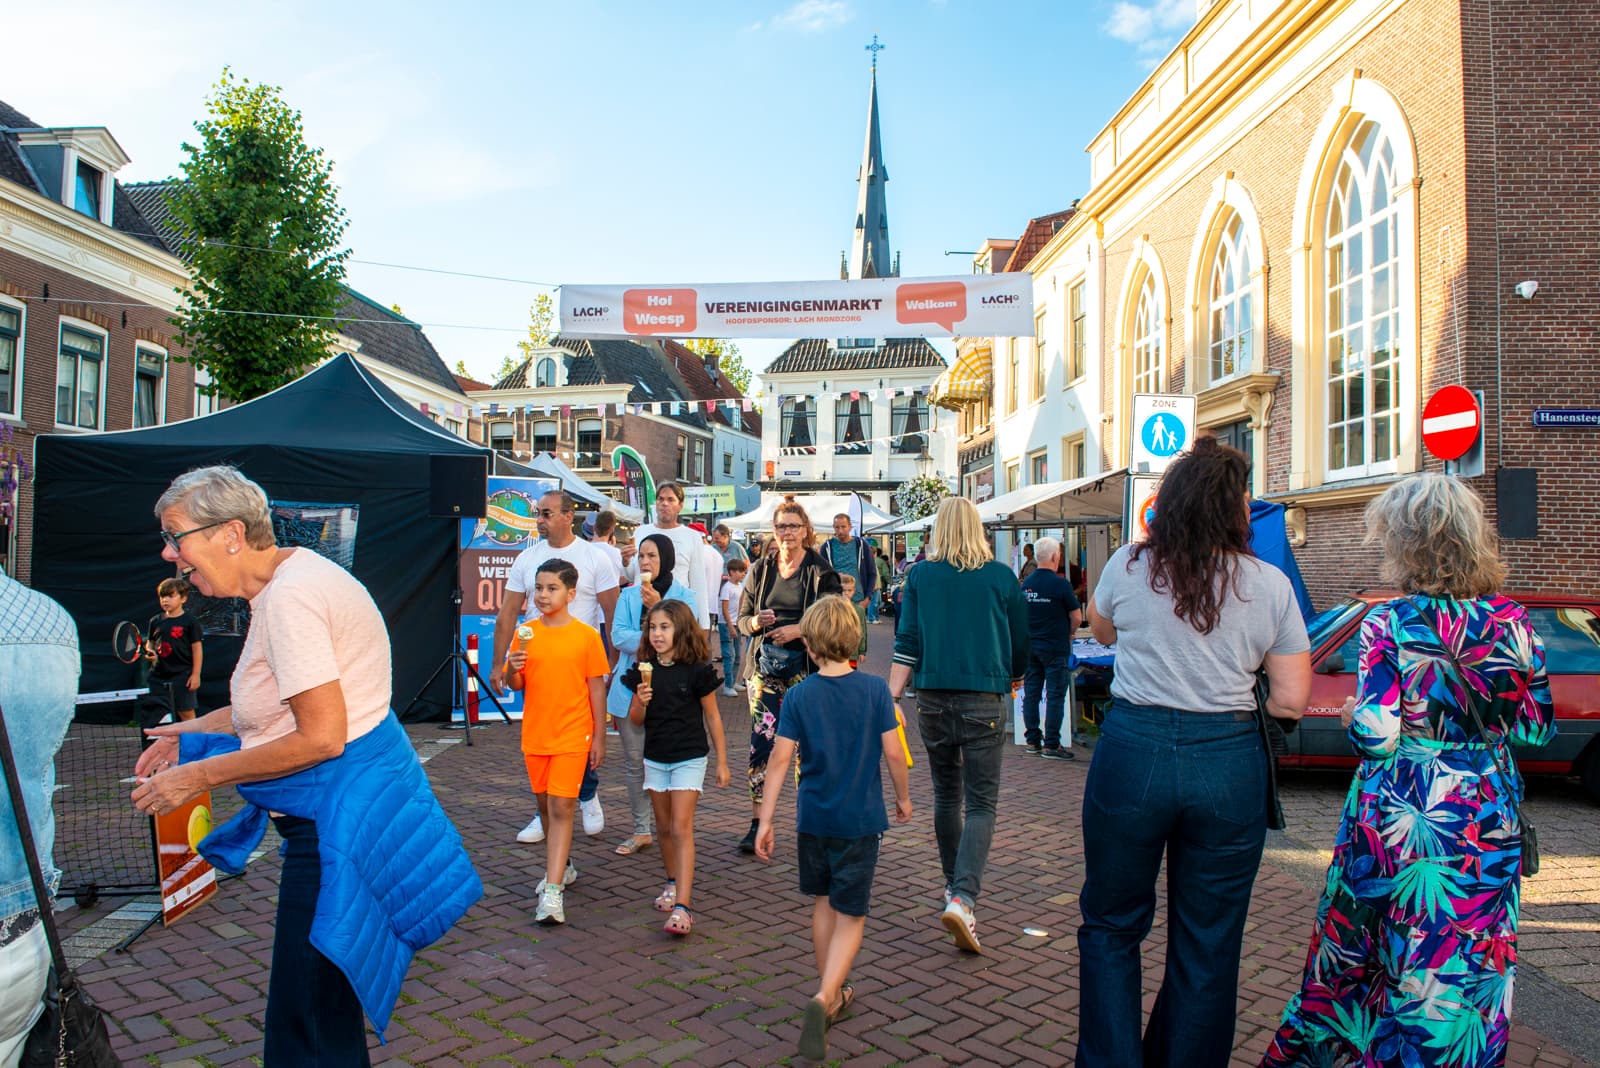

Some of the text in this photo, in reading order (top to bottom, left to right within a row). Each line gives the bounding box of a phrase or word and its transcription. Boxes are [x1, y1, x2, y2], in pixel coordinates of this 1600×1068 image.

[647, 295, 673, 307] Hoi
[982, 295, 1013, 304] LACH
[705, 299, 882, 314] VERENIGINGENMARKT
[905, 300, 958, 311] Welkom
[573, 306, 603, 317] LACH
[634, 313, 686, 328] Weesp
[726, 316, 792, 325] HOOFDSPONSOR:
[816, 315, 862, 323] MONDZORG
[1151, 400, 1177, 408] ZONE
[479, 556, 514, 565] IK HOU
